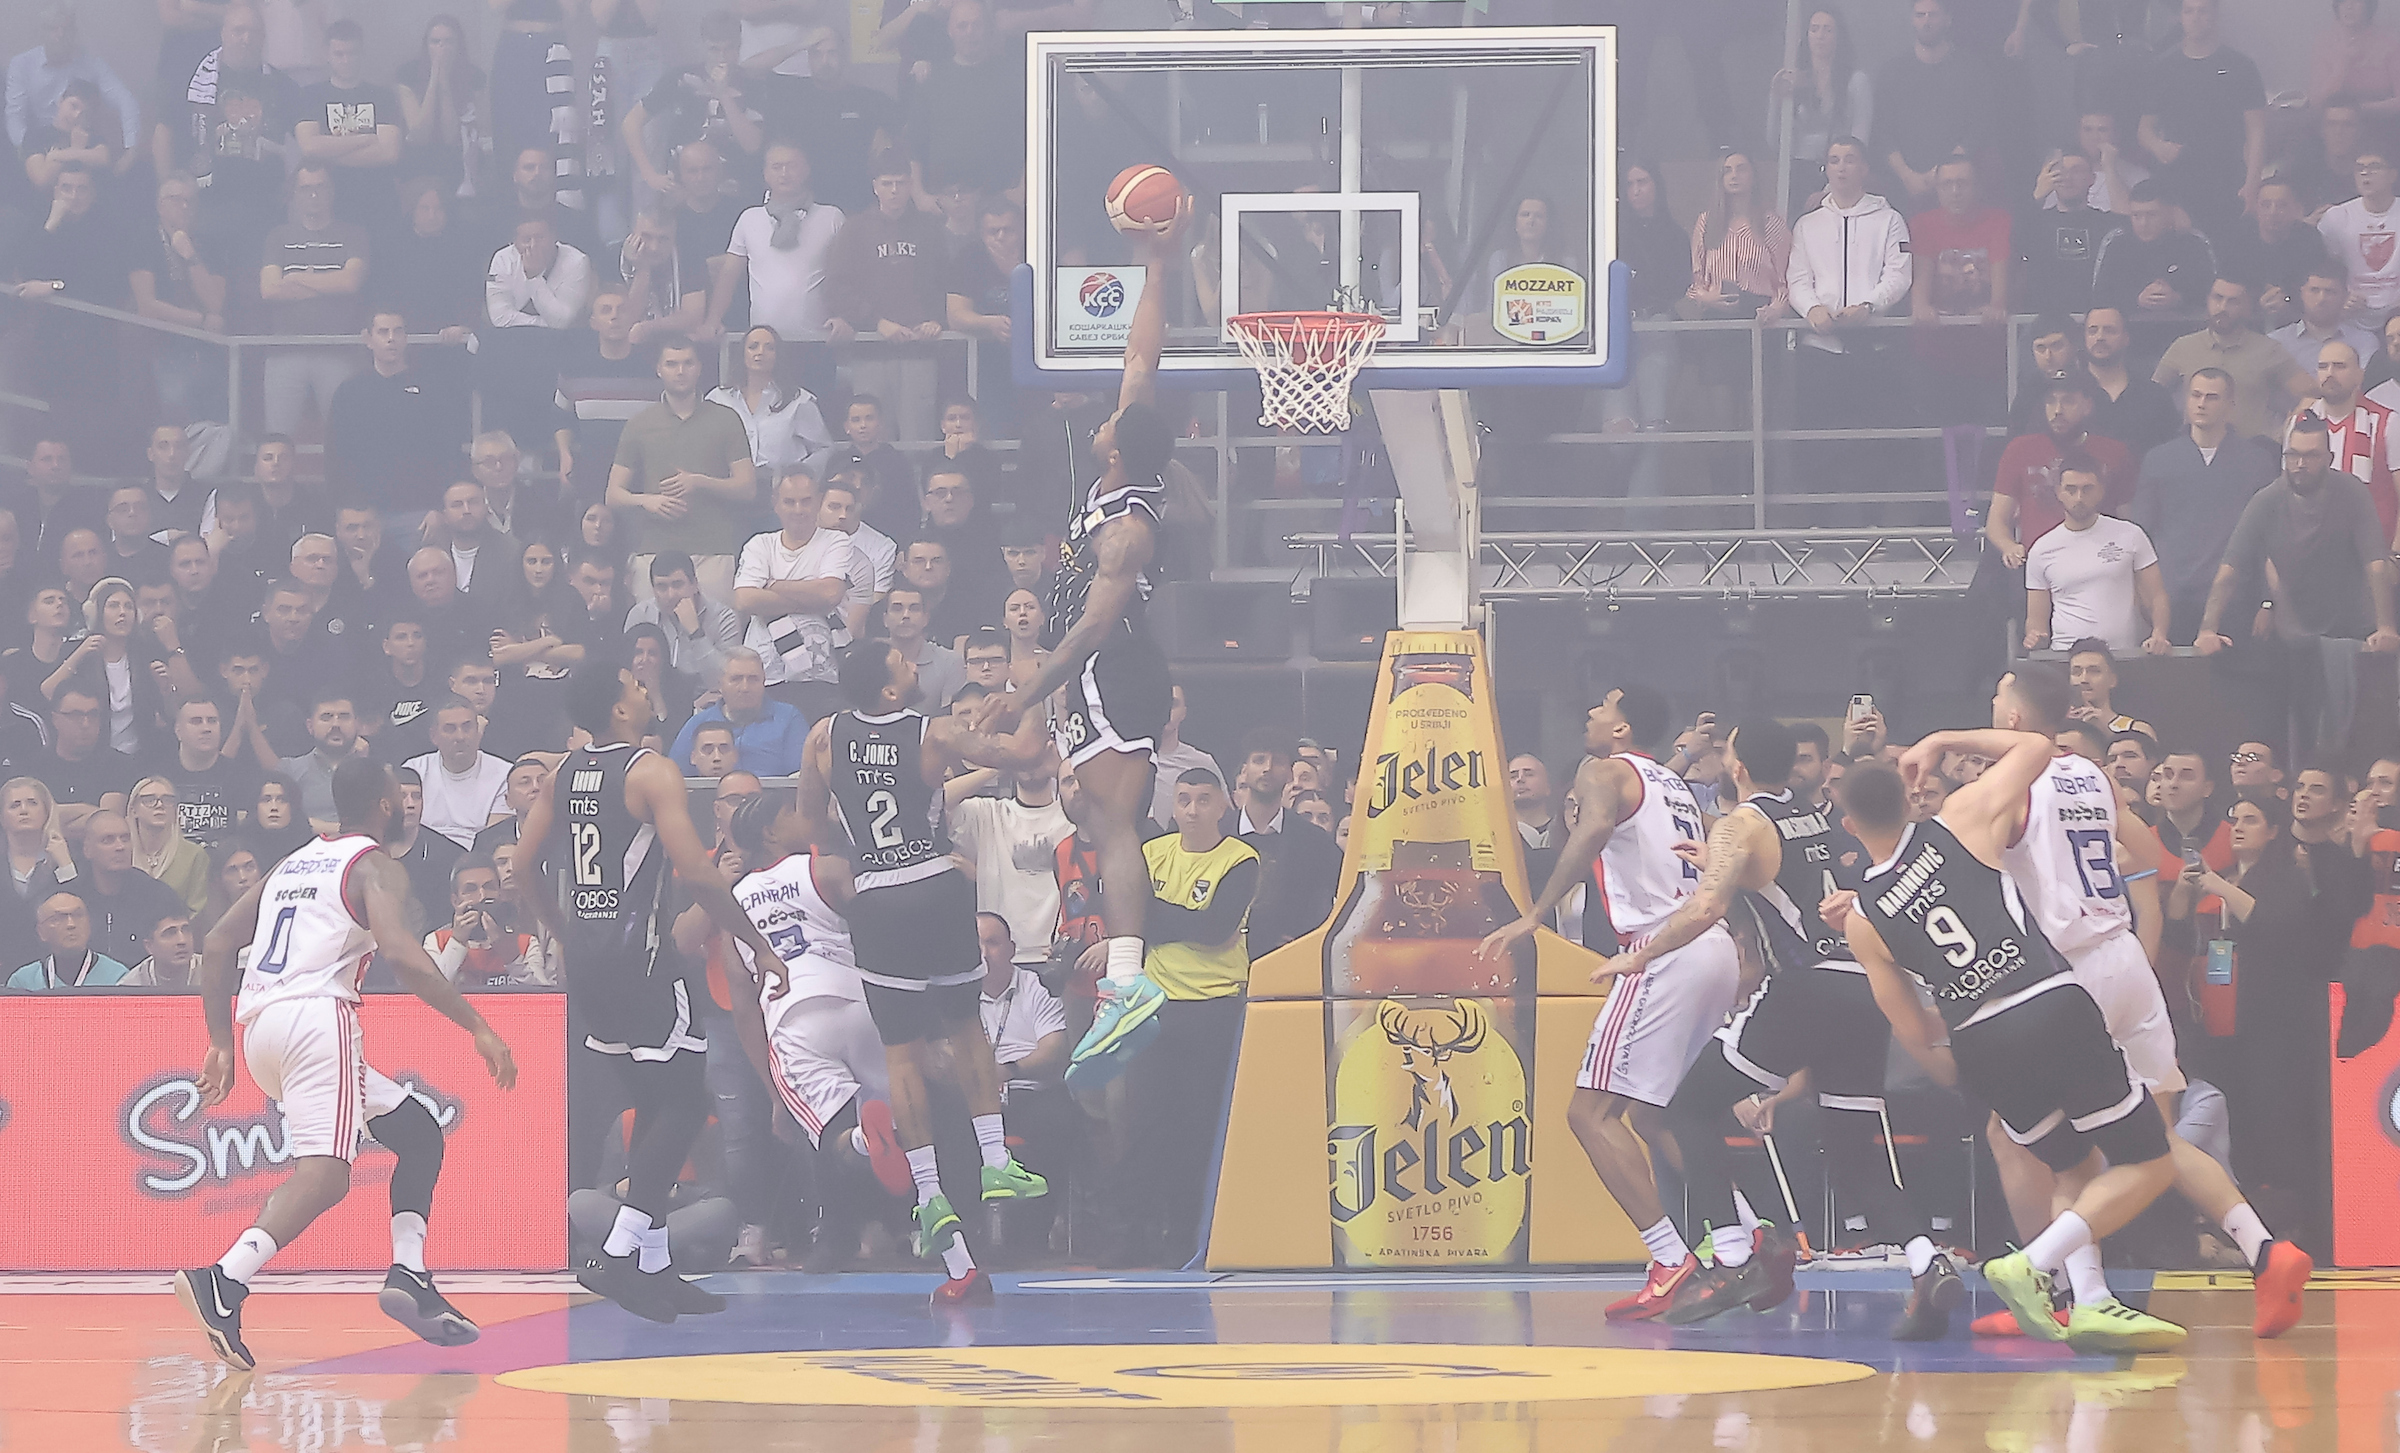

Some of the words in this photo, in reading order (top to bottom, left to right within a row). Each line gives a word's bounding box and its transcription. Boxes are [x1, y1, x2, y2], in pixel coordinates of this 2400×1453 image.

[877, 241, 917, 258] NKE
[1504, 279, 1575, 292] MOZZART
[1410, 720, 1418, 729] U
[856, 769, 896, 786] mts
[1367, 746, 1487, 819] Jelen
[178, 803, 228, 817] RTIZAN
[569, 796, 599, 816] mts
[866, 789, 905, 850] 2
[570, 822, 603, 886] 12
[2066, 829, 2121, 899] 13
[570, 889, 618, 910] OBOS
[1904, 879, 1947, 924] mts
[257, 905, 297, 975] 0
[1924, 904, 1978, 969] 9
[1328, 1116, 1531, 1223] Jelen
[1387, 1202, 1442, 1223] SVETLO
[1448, 1192, 1483, 1211] PIVO
[1412, 1226, 1453, 1241] 1756
